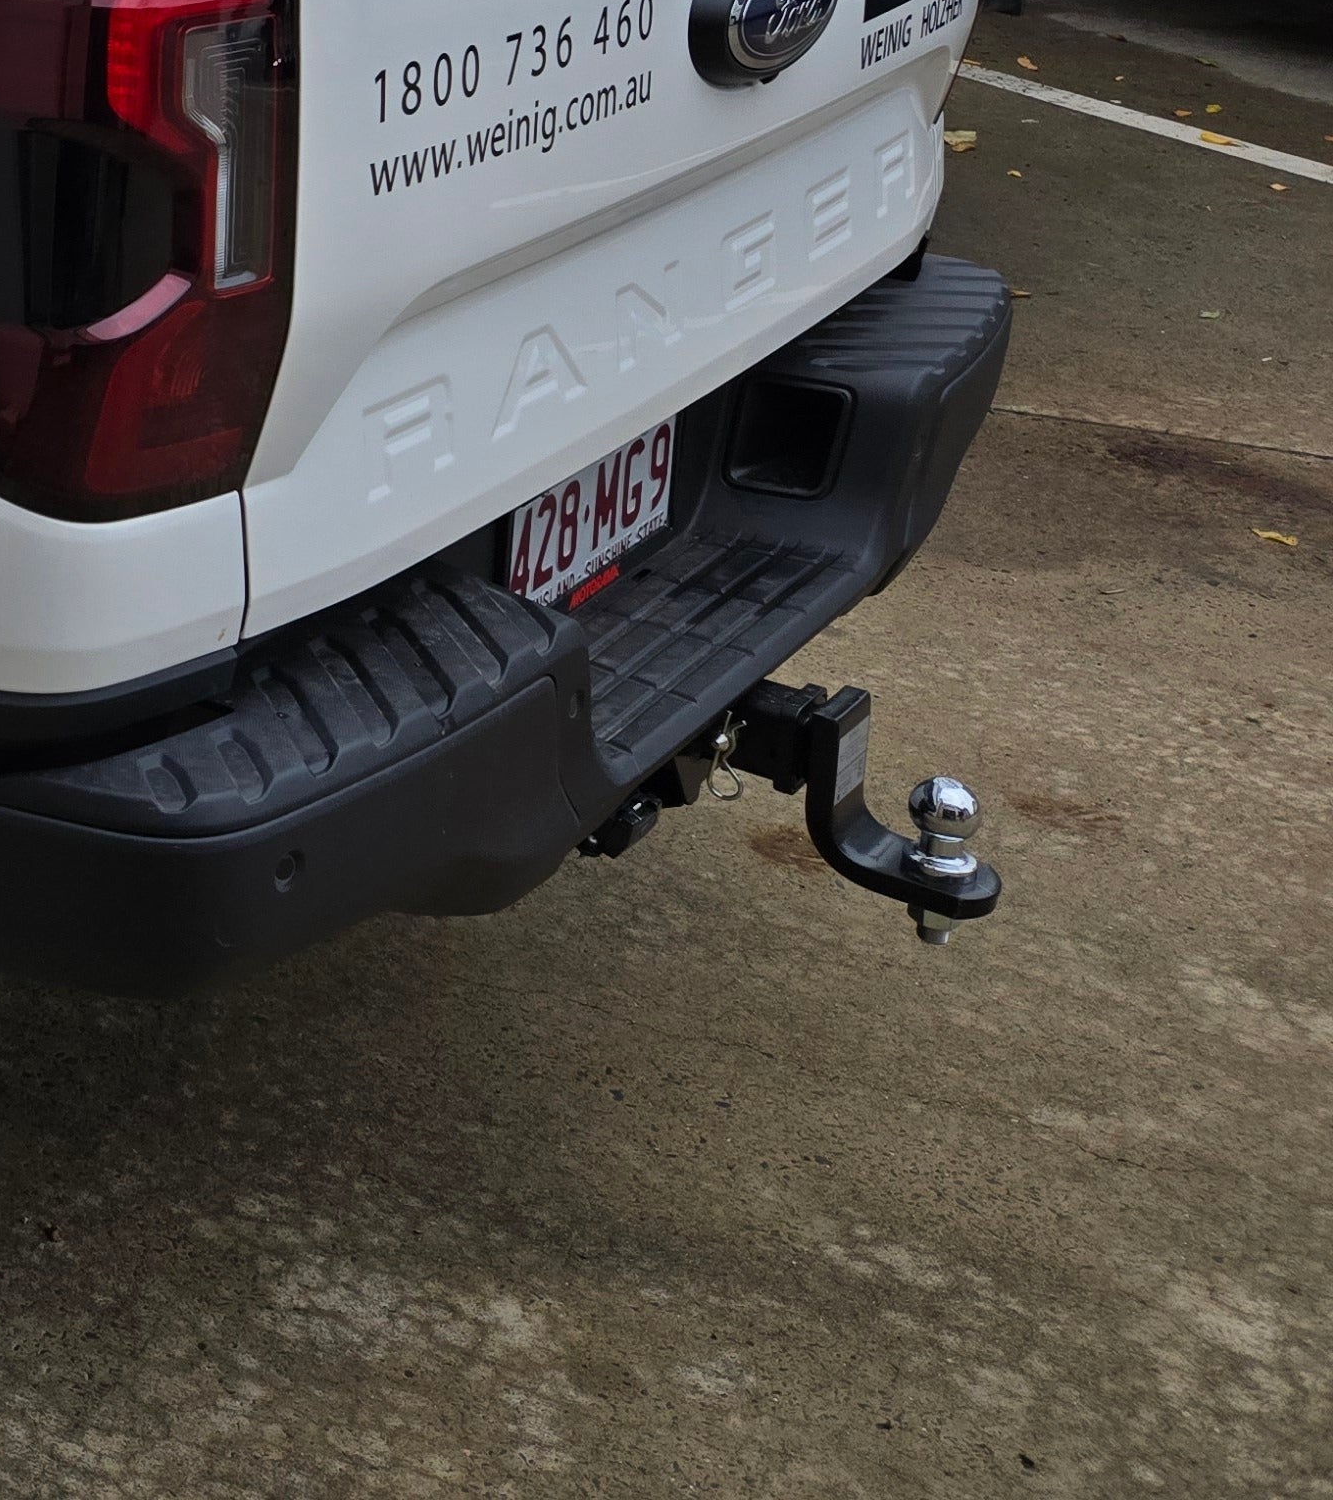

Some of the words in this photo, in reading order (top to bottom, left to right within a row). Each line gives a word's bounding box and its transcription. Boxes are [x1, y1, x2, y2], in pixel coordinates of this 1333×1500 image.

[374, 44, 480, 123] 1800
[506, 15, 573, 86] 736
[860, 14, 913, 70] WEINIG
[369, 70, 653, 197] www.weinig.com.au
[362, 128, 917, 502] RANGER
[584, 532, 633, 578] SUNSHINE
[637, 511, 665, 541] STATE
